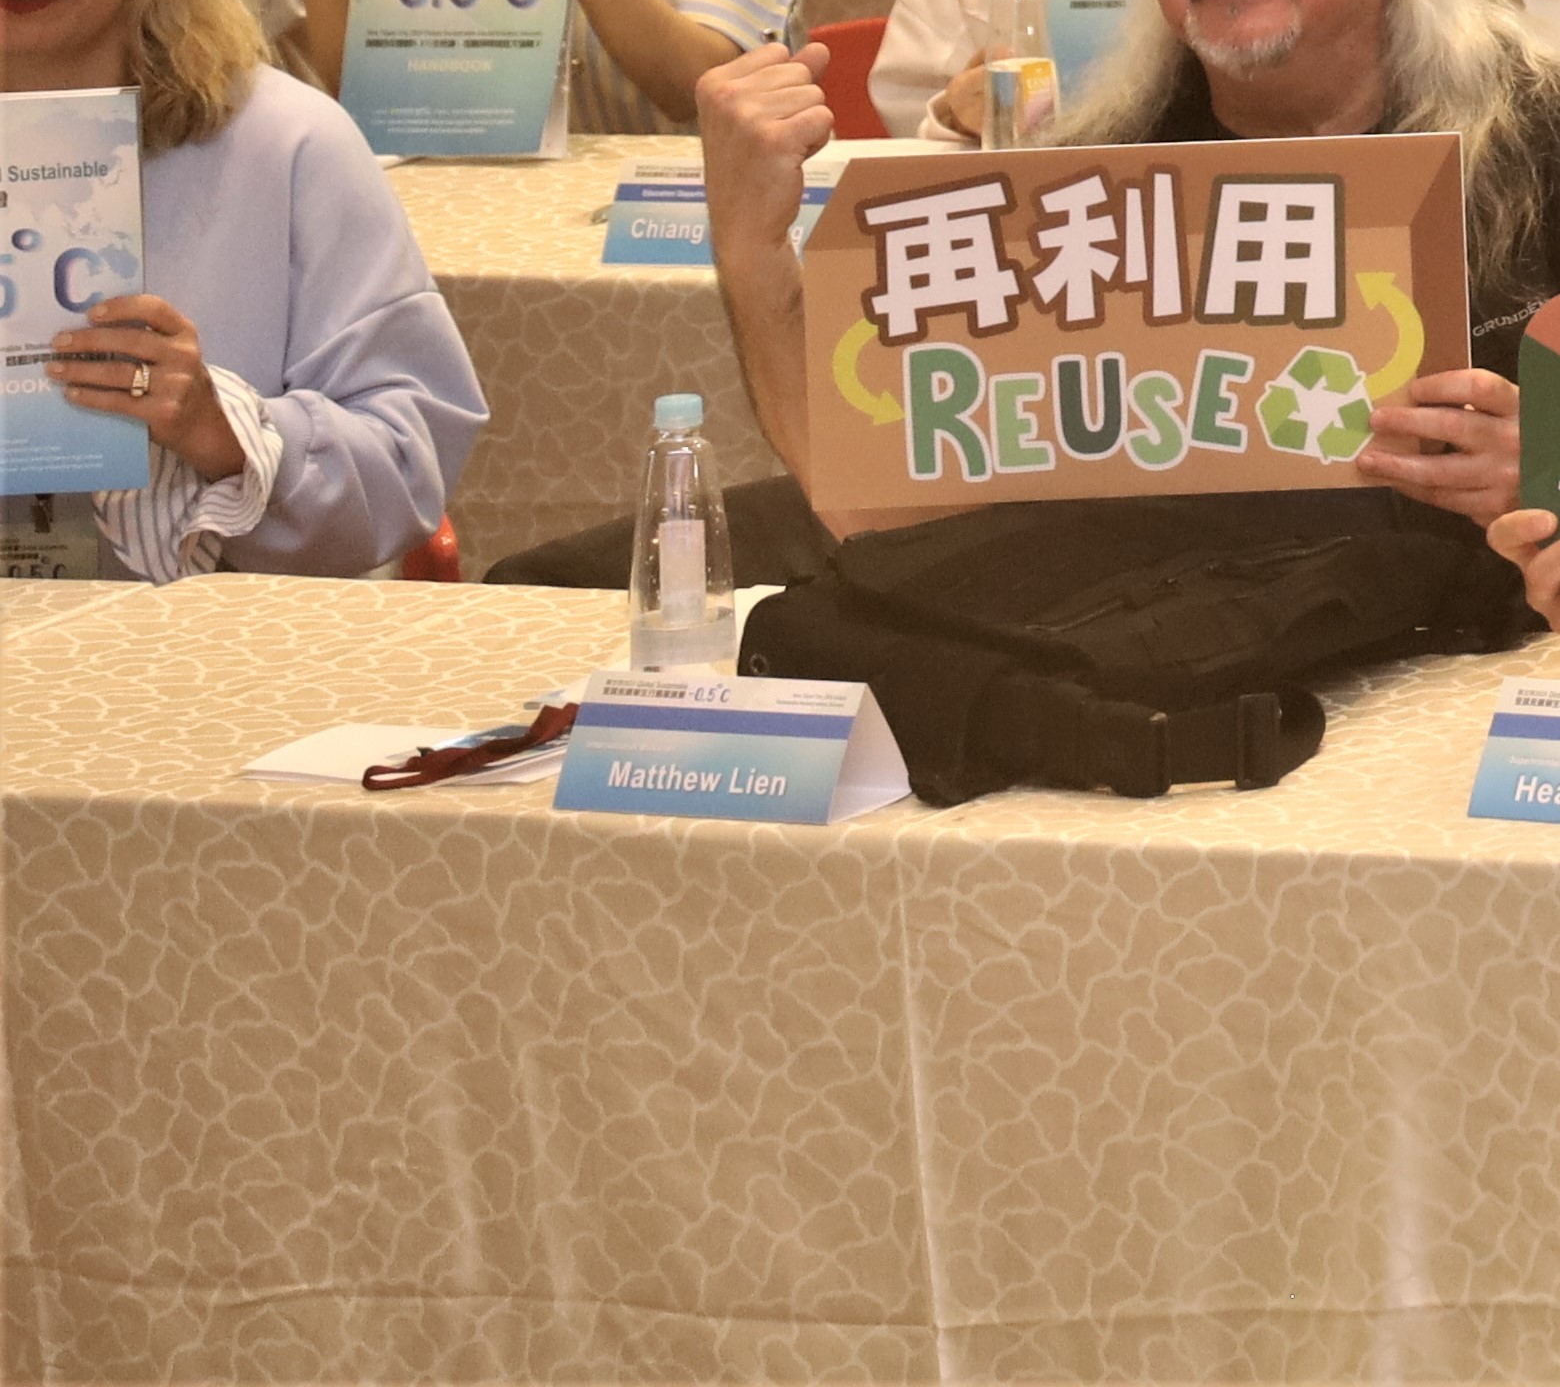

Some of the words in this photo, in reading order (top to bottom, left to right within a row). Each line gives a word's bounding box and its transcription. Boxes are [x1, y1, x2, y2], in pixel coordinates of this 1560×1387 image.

[8, 161, 108, 183] Sustainable
[631, 218, 704, 245] Chiang
[863, 171, 1337, 337] 再利用
[903, 341, 1256, 481] REUSE
[607, 760, 721, 792] Matthew
[728, 767, 787, 797] Lien
